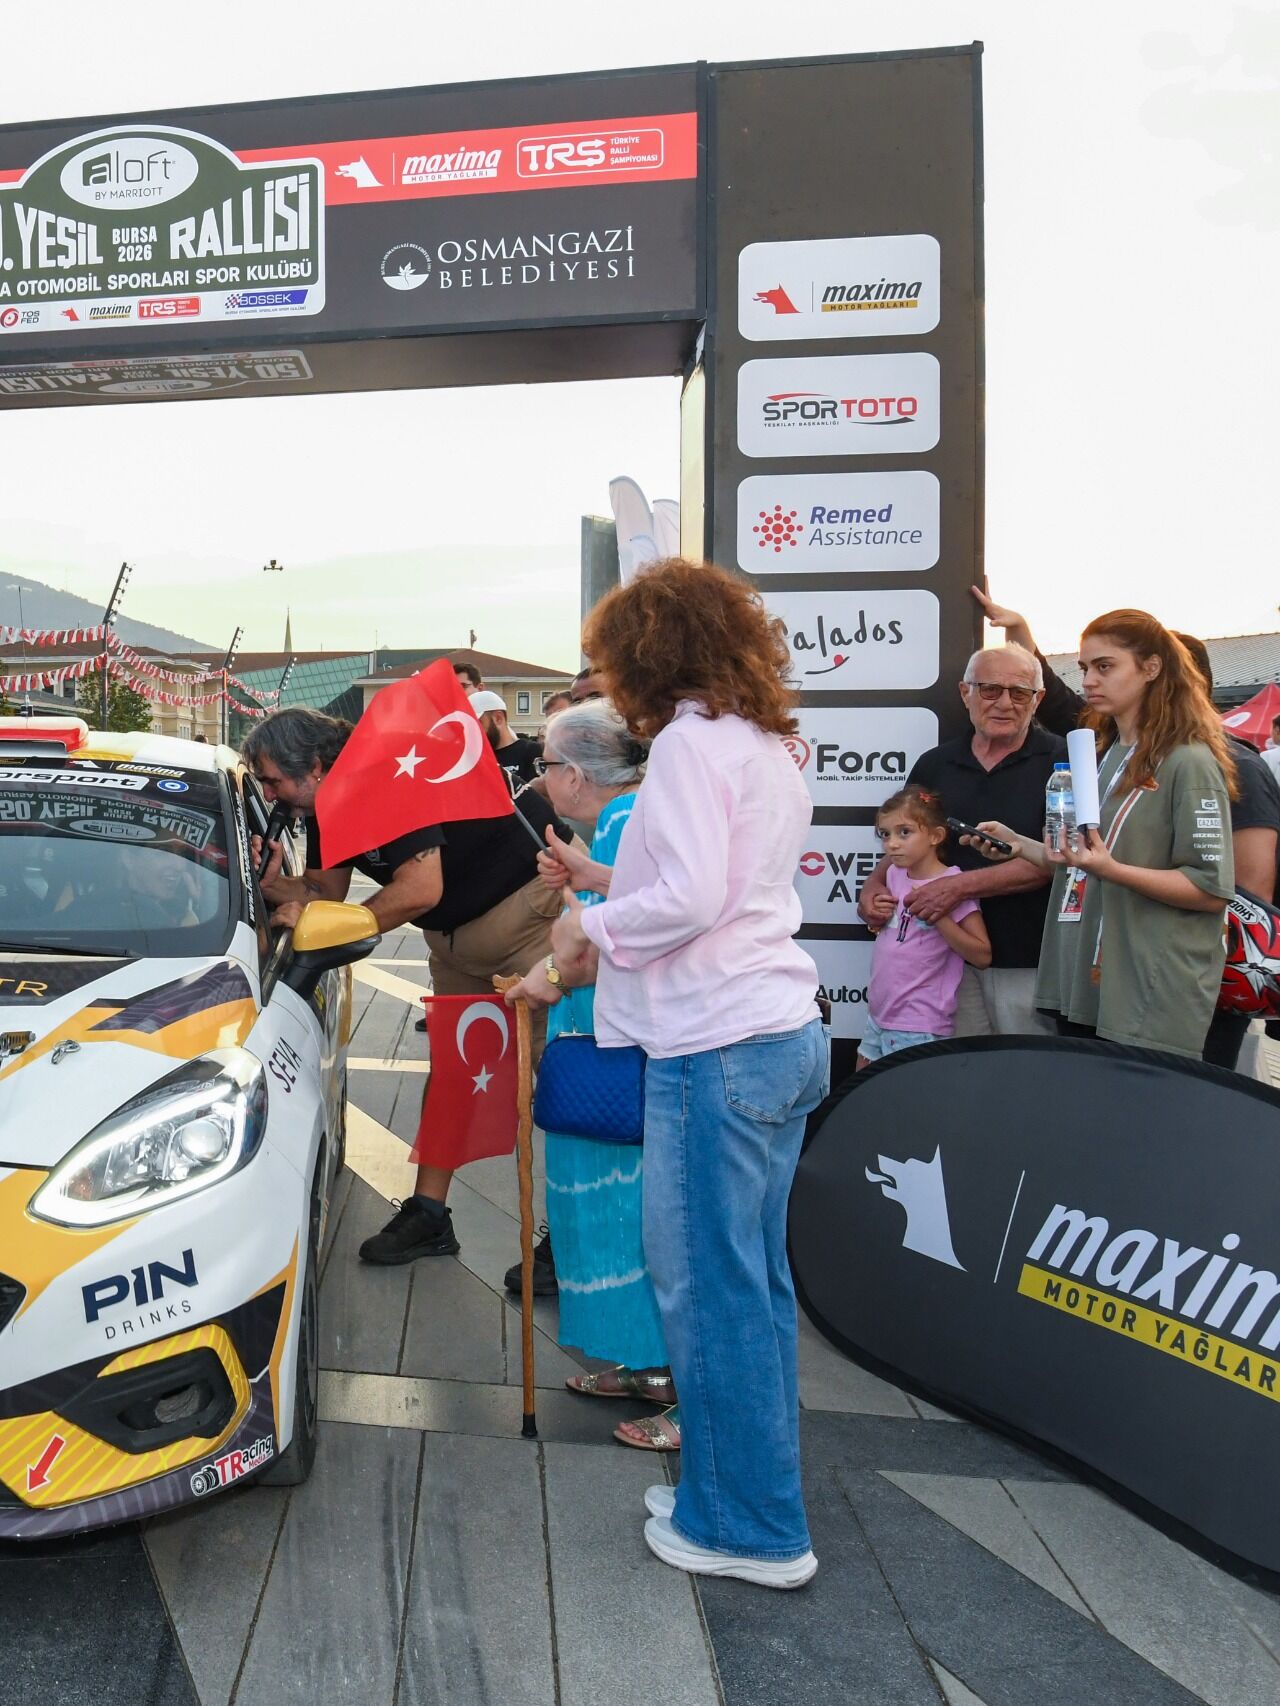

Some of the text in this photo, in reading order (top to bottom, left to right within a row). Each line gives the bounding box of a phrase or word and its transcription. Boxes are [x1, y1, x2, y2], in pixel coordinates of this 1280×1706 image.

[610, 136, 640, 146] TÜRKİYE
[610, 145, 630, 155] RALLİ
[402, 146, 502, 176] maxima
[522, 139, 606, 171] TRS
[610, 153, 658, 166] ŞAMPİYONASI
[82, 150, 173, 187] aloft
[411, 170, 489, 183] MOTOR YAĞLARI
[95, 187, 163, 201] BY MARRIOTT
[170, 173, 310, 260] RALLİSİ
[112, 226, 157, 245] BURSA
[437, 225, 635, 264] OSMANGAZİ
[118, 245, 153, 262] 2026
[17, 272, 101, 296] OTOMOBİL
[107, 270, 189, 291] SPORLARI
[196, 267, 240, 284] SPOR
[247, 258, 312, 281] KULÜBÜ
[439, 256, 636, 289] BELEDİYESİ
[240, 293, 292, 305] BOSSEK
[822, 278, 923, 302] maxima
[22, 310, 40, 318] TOS
[89, 304, 132, 316] maxima
[140, 302, 176, 316] TRS
[830, 301, 909, 311] MOTOR YAĞLARI
[810, 504, 893, 524] Remed
[809, 527, 923, 547] Assistance
[817, 744, 906, 773] Fora
[118, 762, 186, 777] maxima
[816, 774, 906, 782] MOBİL TAKİP SİSTEMLERİ
[81, 1248, 199, 1323] PIN
[1044, 1279, 1135, 1333] MOTOR
[105, 1299, 192, 1340] DRINKS
